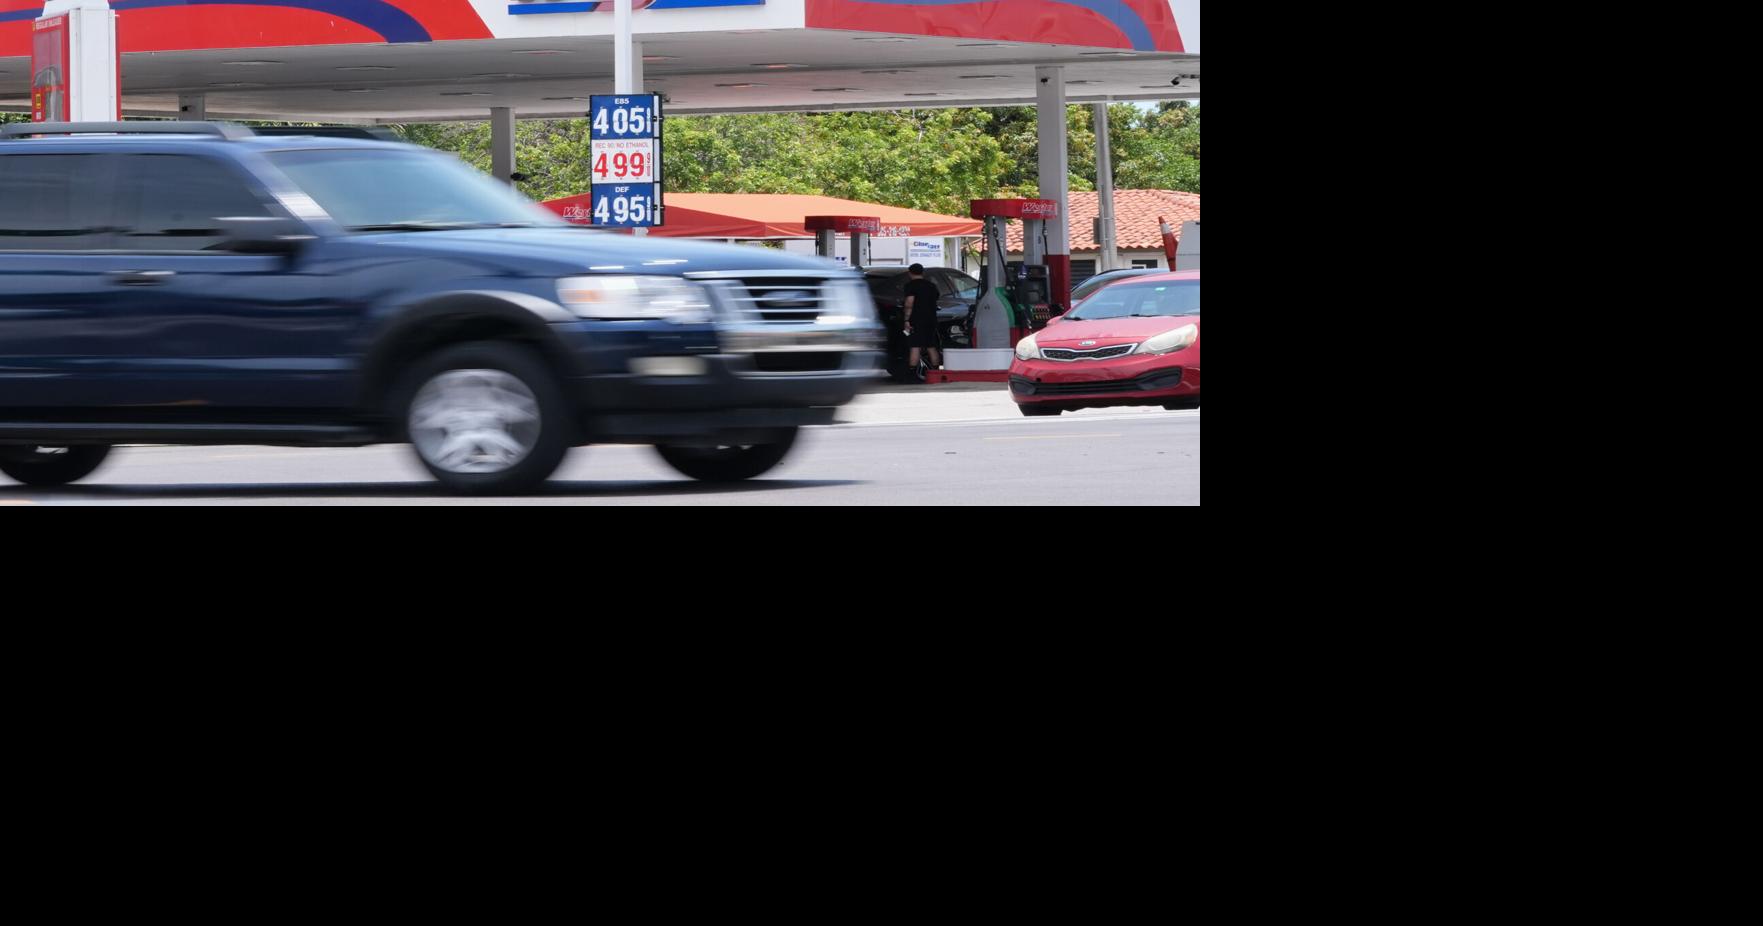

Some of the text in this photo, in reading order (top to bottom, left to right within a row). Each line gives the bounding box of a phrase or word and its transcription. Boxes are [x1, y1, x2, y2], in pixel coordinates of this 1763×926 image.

[593, 107, 646, 135] 405
[593, 152, 645, 178] 499
[594, 196, 646, 223] 495
